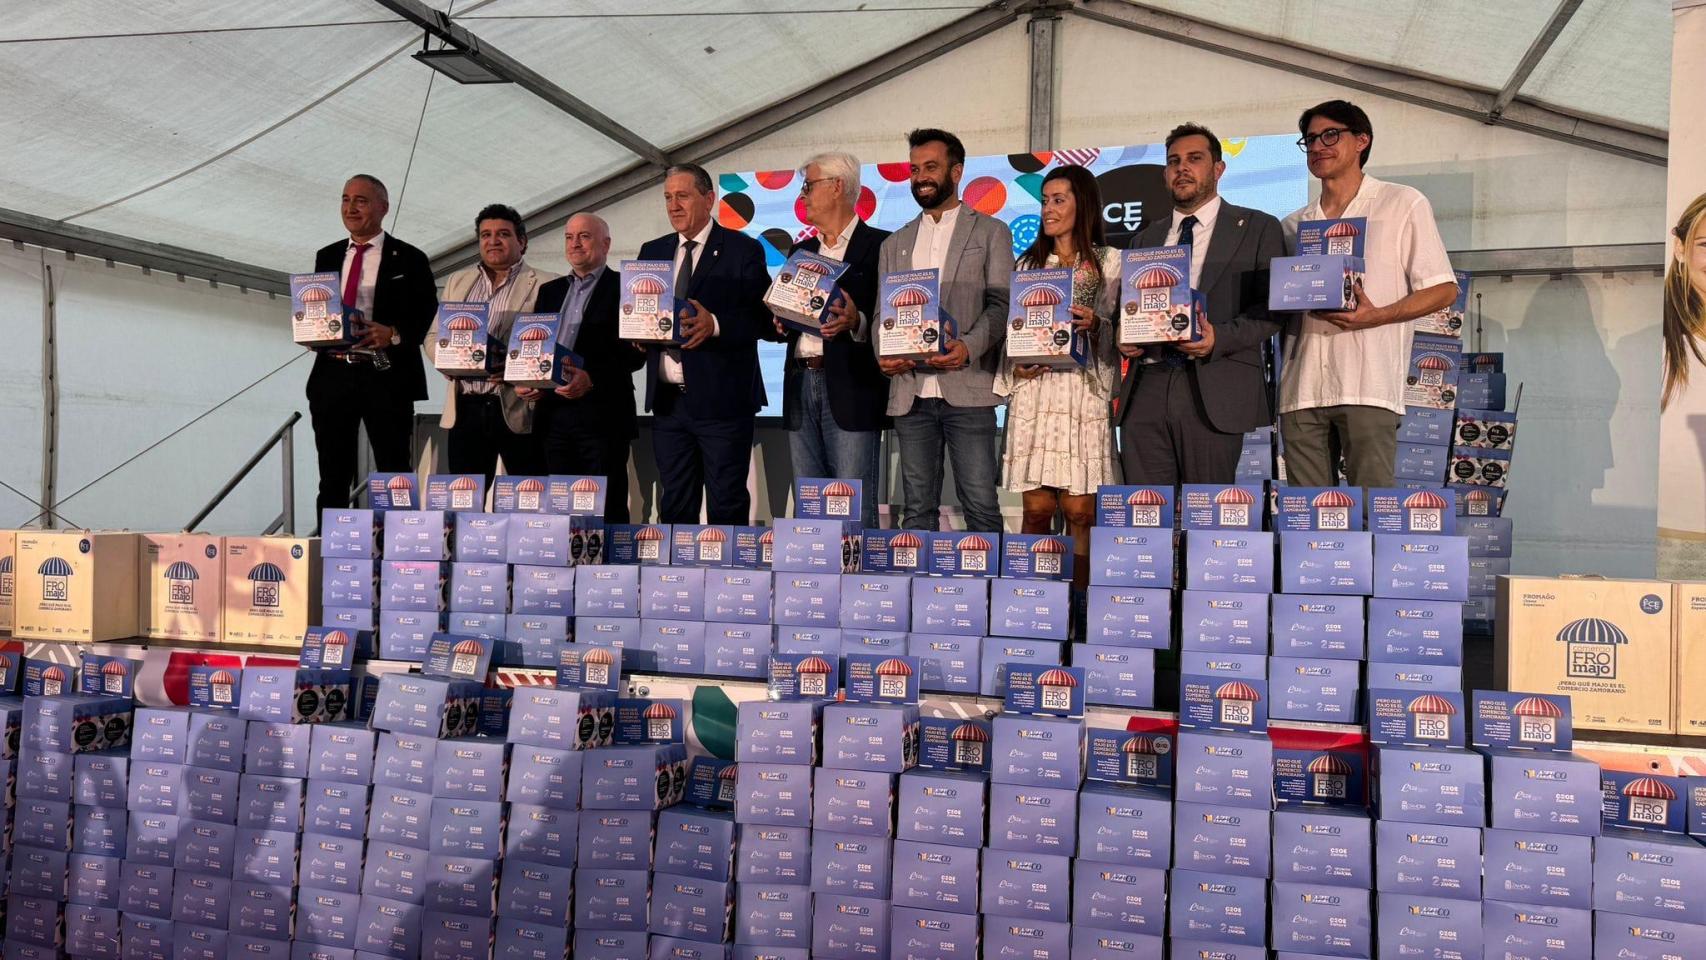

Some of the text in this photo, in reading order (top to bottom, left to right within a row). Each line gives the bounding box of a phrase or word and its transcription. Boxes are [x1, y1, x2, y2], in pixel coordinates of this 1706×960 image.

[1144, 293, 1167, 302] FRO
[1144, 302, 1167, 311] majo
[1029, 311, 1050, 320] FRO
[1136, 510, 1157, 518] FRO
[1223, 509, 1245, 517] FRO
[1321, 512, 1345, 520] FRO
[1413, 513, 1437, 522] FRO
[1223, 517, 1245, 525] majo
[1321, 520, 1345, 528] majo
[1413, 521, 1438, 529] majo
[46, 581, 65, 590] FRO
[172, 585, 190, 594] FRO
[46, 590, 65, 598] majo
[1572, 652, 1610, 665] FRO
[1572, 664, 1610, 676] majo
[803, 678, 823, 686] FRO
[882, 680, 903, 688] FRO
[882, 688, 903, 696] majo
[1045, 690, 1067, 699] FRO
[1045, 699, 1067, 708] majo
[1225, 704, 1249, 715] FRO
[1224, 713, 1249, 723] majo
[1418, 719, 1445, 729] FRO
[1523, 723, 1551, 733] FRO
[1418, 728, 1445, 738] majo
[1523, 732, 1551, 741] majo
[1634, 803, 1663, 814] FRO
[1633, 812, 1663, 822] majo
